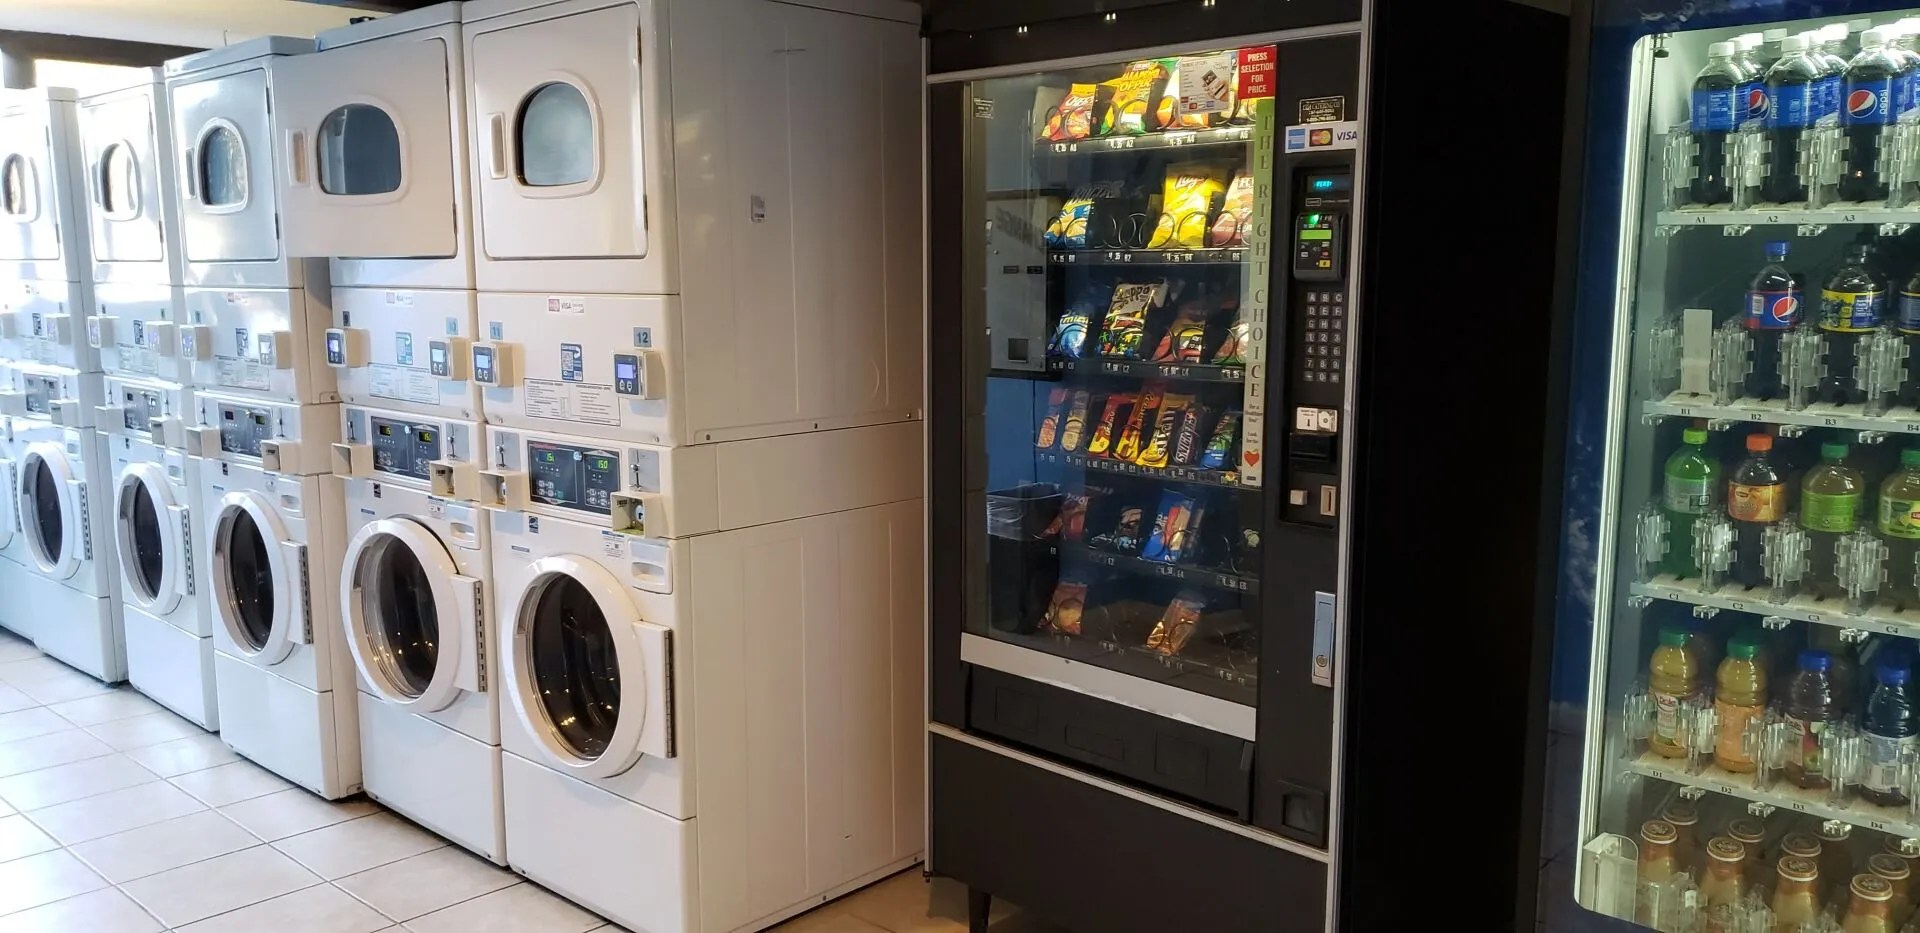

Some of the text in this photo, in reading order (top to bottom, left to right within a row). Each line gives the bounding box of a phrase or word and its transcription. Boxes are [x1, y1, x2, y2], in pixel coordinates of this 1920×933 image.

[1247, 52, 1268, 61] PRESS
[1240, 62, 1275, 73] SELECTION
[1251, 74, 1264, 83] FOR
[1247, 85, 1268, 93] PRICE
[1880, 89, 1888, 115] pepsi
[1336, 131, 1357, 141] VISA
[1260, 115, 1272, 169] THE
[1695, 215, 1706, 224] A1
[1766, 215, 1778, 223] A2
[1842, 214, 1855, 222] A3
[1256, 183, 1268, 276] RIGHT
[636, 332, 649, 344] 12
[1250, 289, 1265, 397] CHOICE
[1176, 411, 1198, 463] SNICKERS
[1732, 602, 1744, 610] C2
[1808, 614, 1820, 622] C3
[1886, 626, 1899, 634] C4
[1652, 770, 1663, 778] D1
[1721, 786, 1732, 794] D2
[1792, 803, 1805, 811] D3
[1870, 821, 1883, 829] D4
